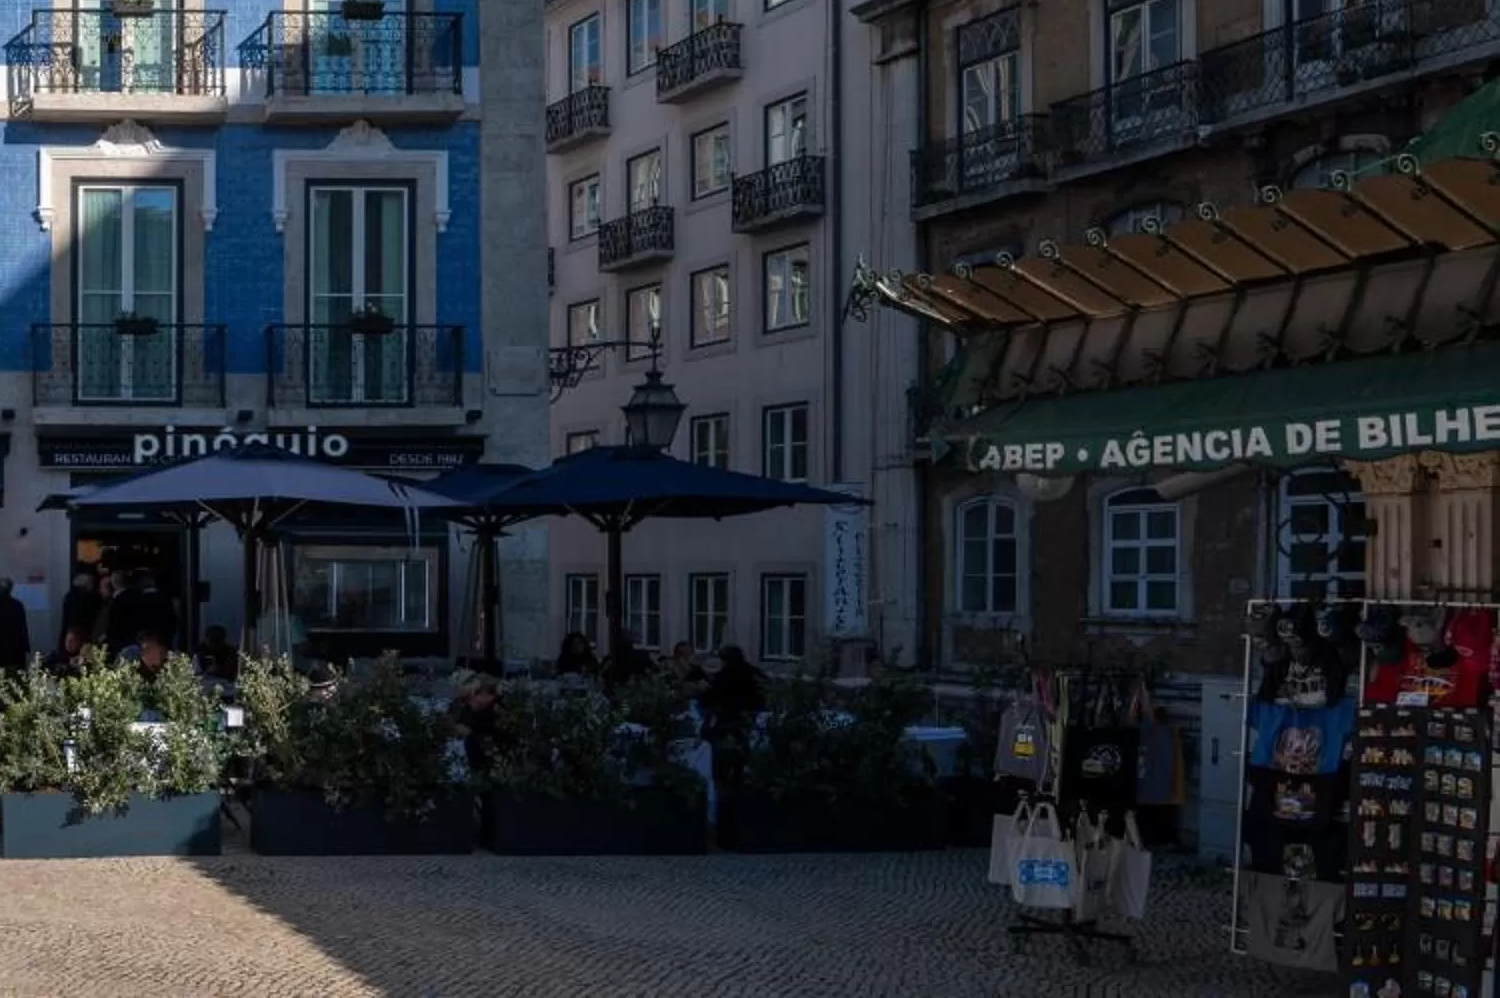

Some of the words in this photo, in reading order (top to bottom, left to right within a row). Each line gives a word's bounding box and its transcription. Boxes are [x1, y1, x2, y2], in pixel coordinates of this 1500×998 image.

[979, 442, 1066, 471] ABEP
[1285, 419, 1341, 455] DE
[1358, 405, 1500, 449] BILHE
